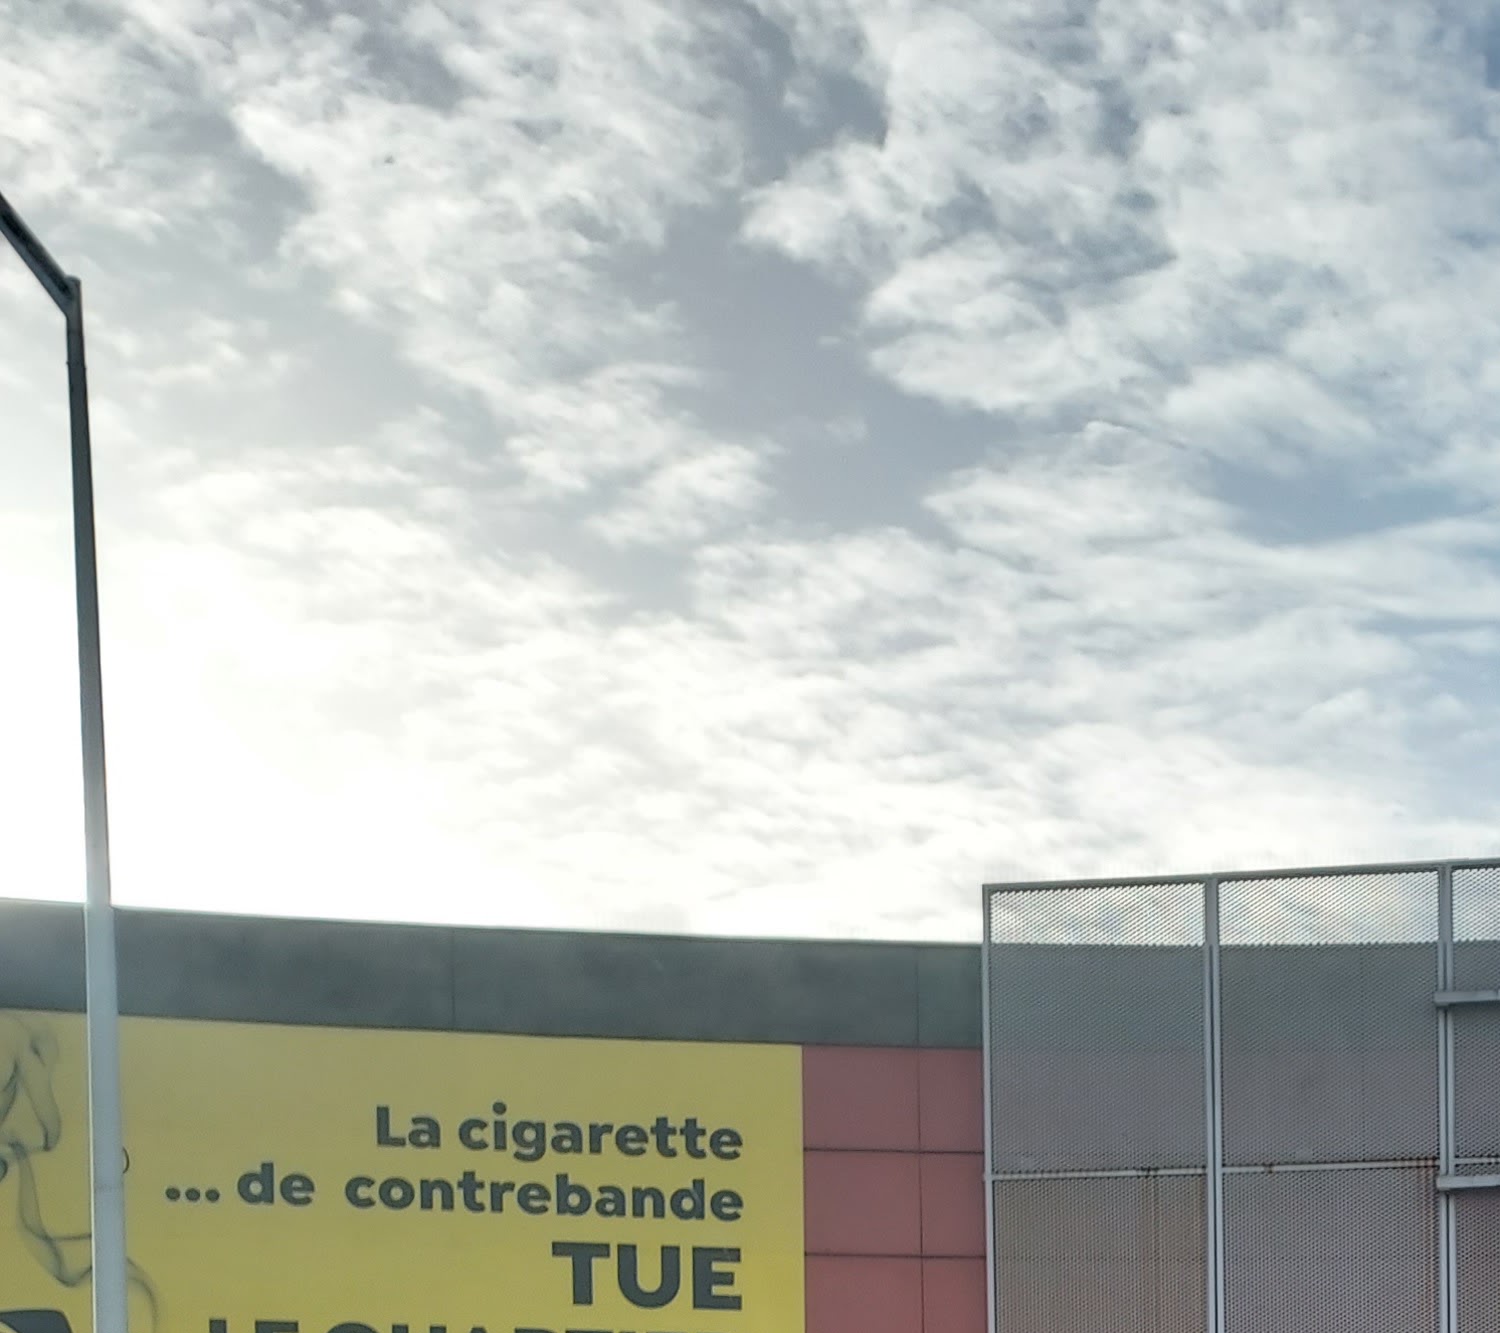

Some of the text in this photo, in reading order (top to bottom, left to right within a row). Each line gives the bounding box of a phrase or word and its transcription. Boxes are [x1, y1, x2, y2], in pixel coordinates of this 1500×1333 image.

[375, 1101, 744, 1163] La cigarette
[343, 1170, 744, 1222] contrebande
[551, 1240, 744, 1312] TUE
